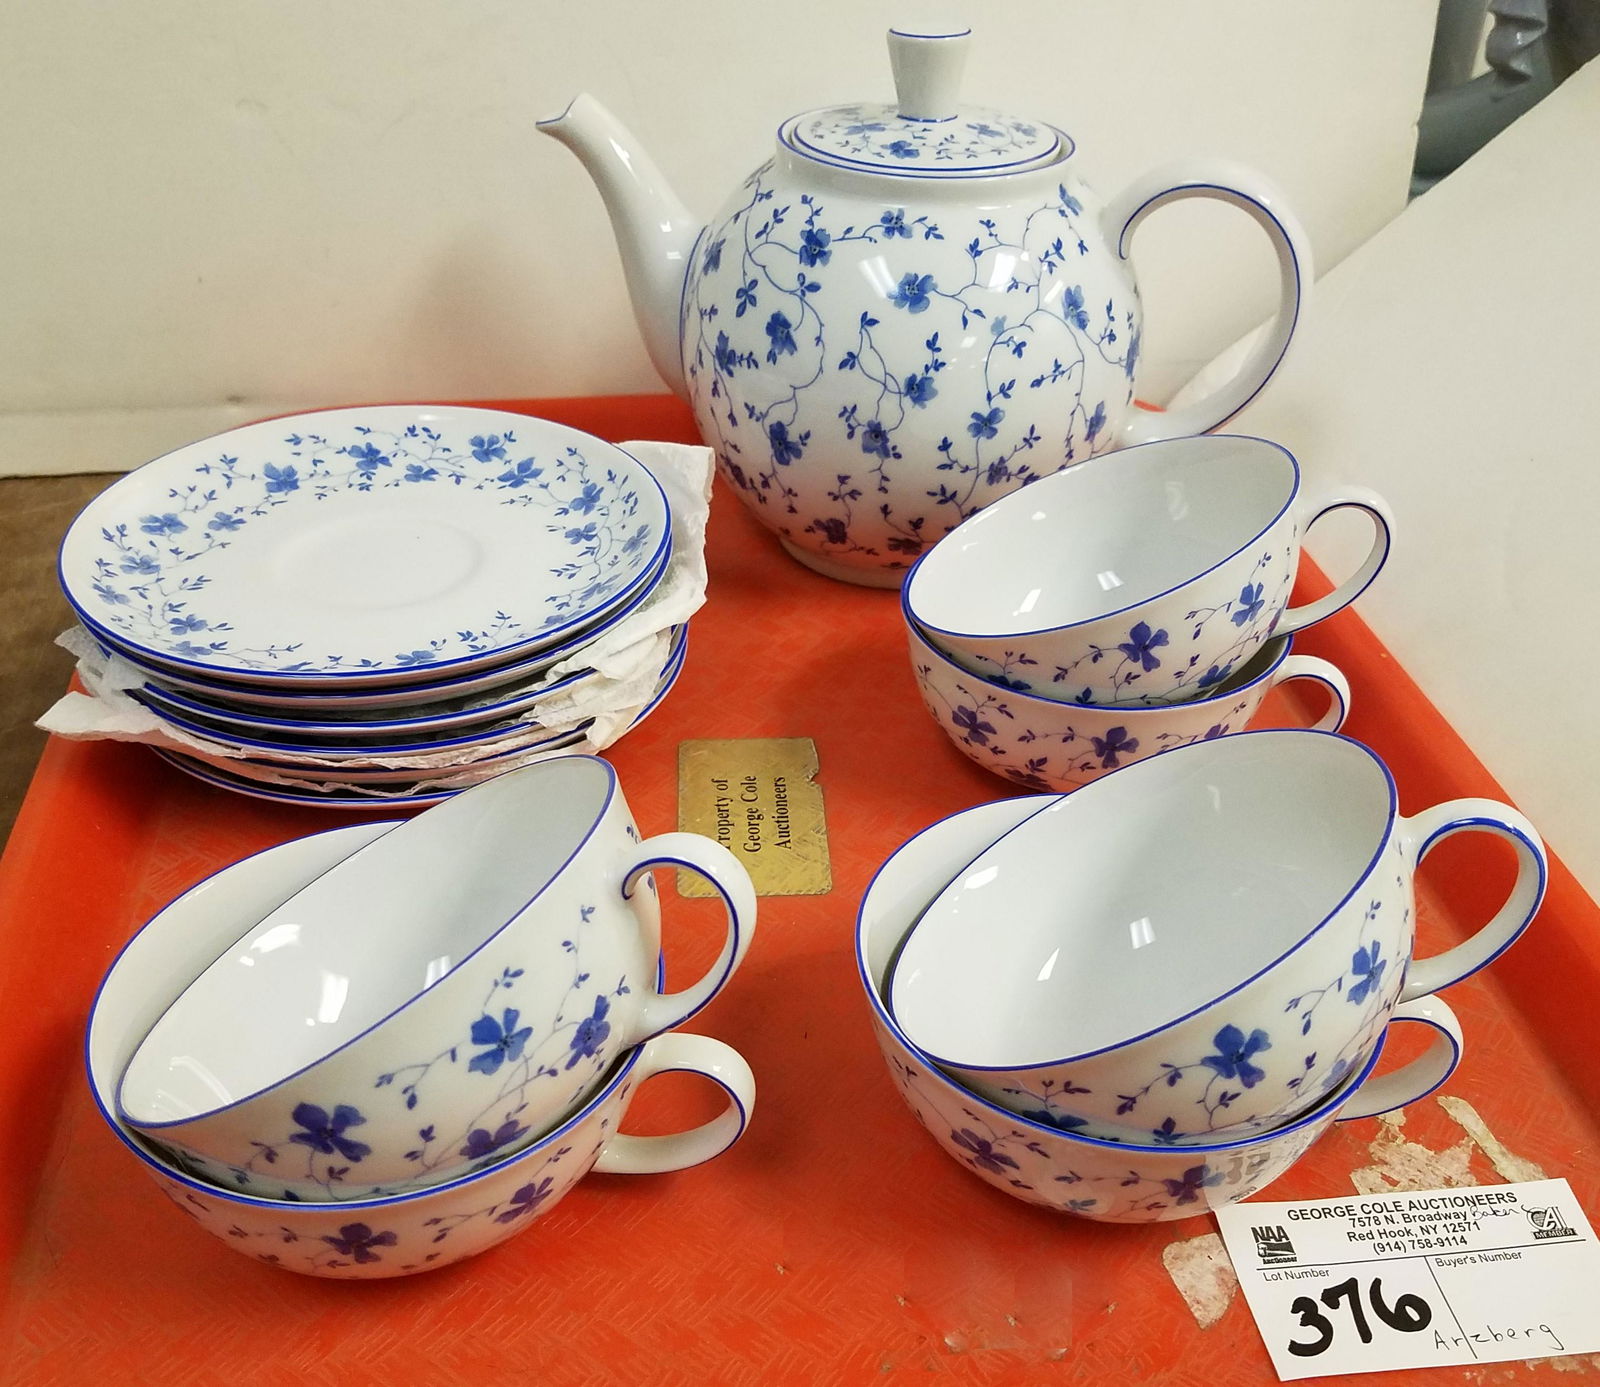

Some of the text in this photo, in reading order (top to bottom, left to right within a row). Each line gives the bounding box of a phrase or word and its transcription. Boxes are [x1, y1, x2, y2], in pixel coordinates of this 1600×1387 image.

[711, 778, 728, 791] of
[740, 775, 764, 852] George Cole
[772, 777, 792, 849] Auctioneers
[1287, 1192, 1518, 1221] GEORGE COLE AUCTIONEERS
[1349, 1210, 1467, 1228] 7578 N. Broadway
[1250, 1225, 1290, 1243] NAA
[1347, 1221, 1481, 1242] Red Hook, NY 12571
[1373, 1235, 1468, 1255] (914) 758-9114
[1435, 1250, 1523, 1268] Buyer's Number
[1263, 1269, 1330, 1282] Lot Number
[1287, 1277, 1432, 1357] 376
[1433, 1324, 1565, 1351] Arzberg
